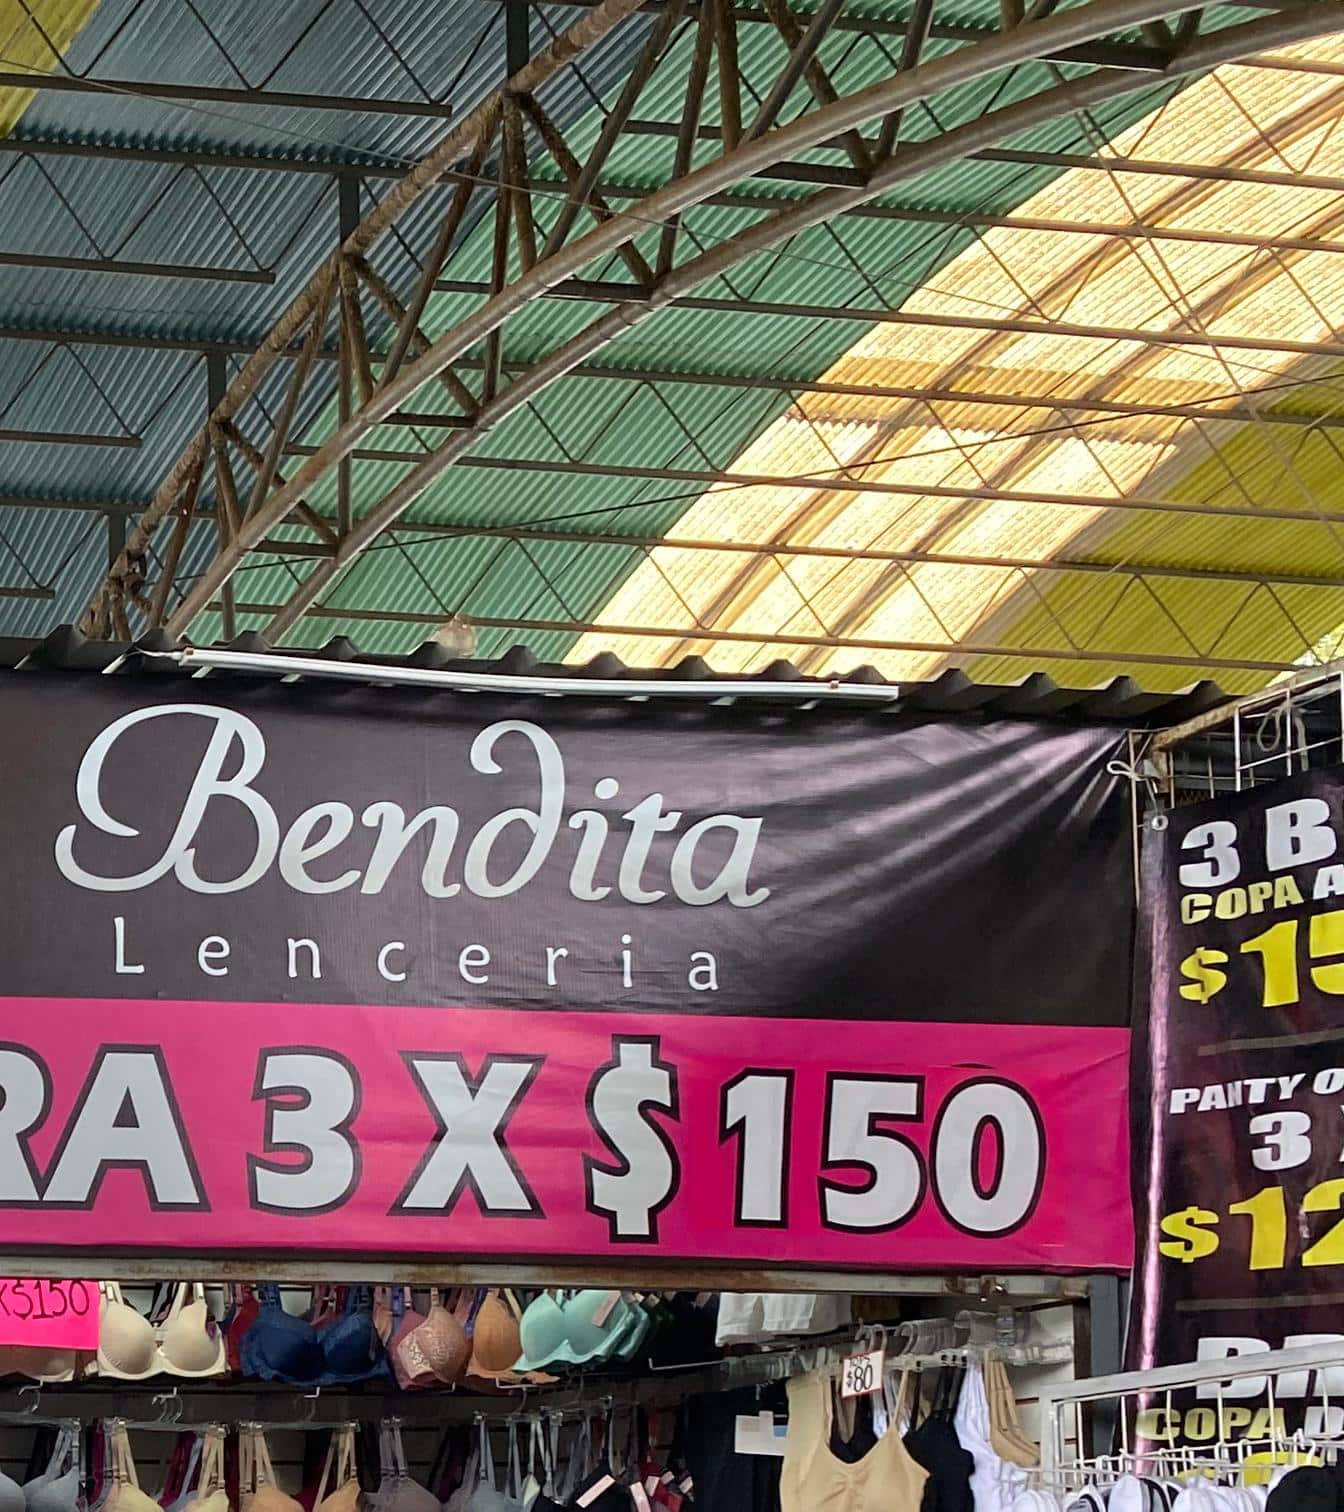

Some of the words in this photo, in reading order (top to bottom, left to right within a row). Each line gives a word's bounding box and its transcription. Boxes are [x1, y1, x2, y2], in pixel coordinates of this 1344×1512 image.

[54, 703, 770, 909] Bendita
[1179, 820, 1240, 888] 3
[1180, 875, 1305, 924] COPA
[115, 916, 719, 992] Lenceria
[1169, 1073, 1306, 1114] PANTY
[245, 1044, 362, 1216] 3
[388, 1050, 550, 1219] X
[1249, 1111, 1312, 1171] 3
[846, 1364, 873, 1393] $80
[1135, 1407, 1288, 1441] COPA
